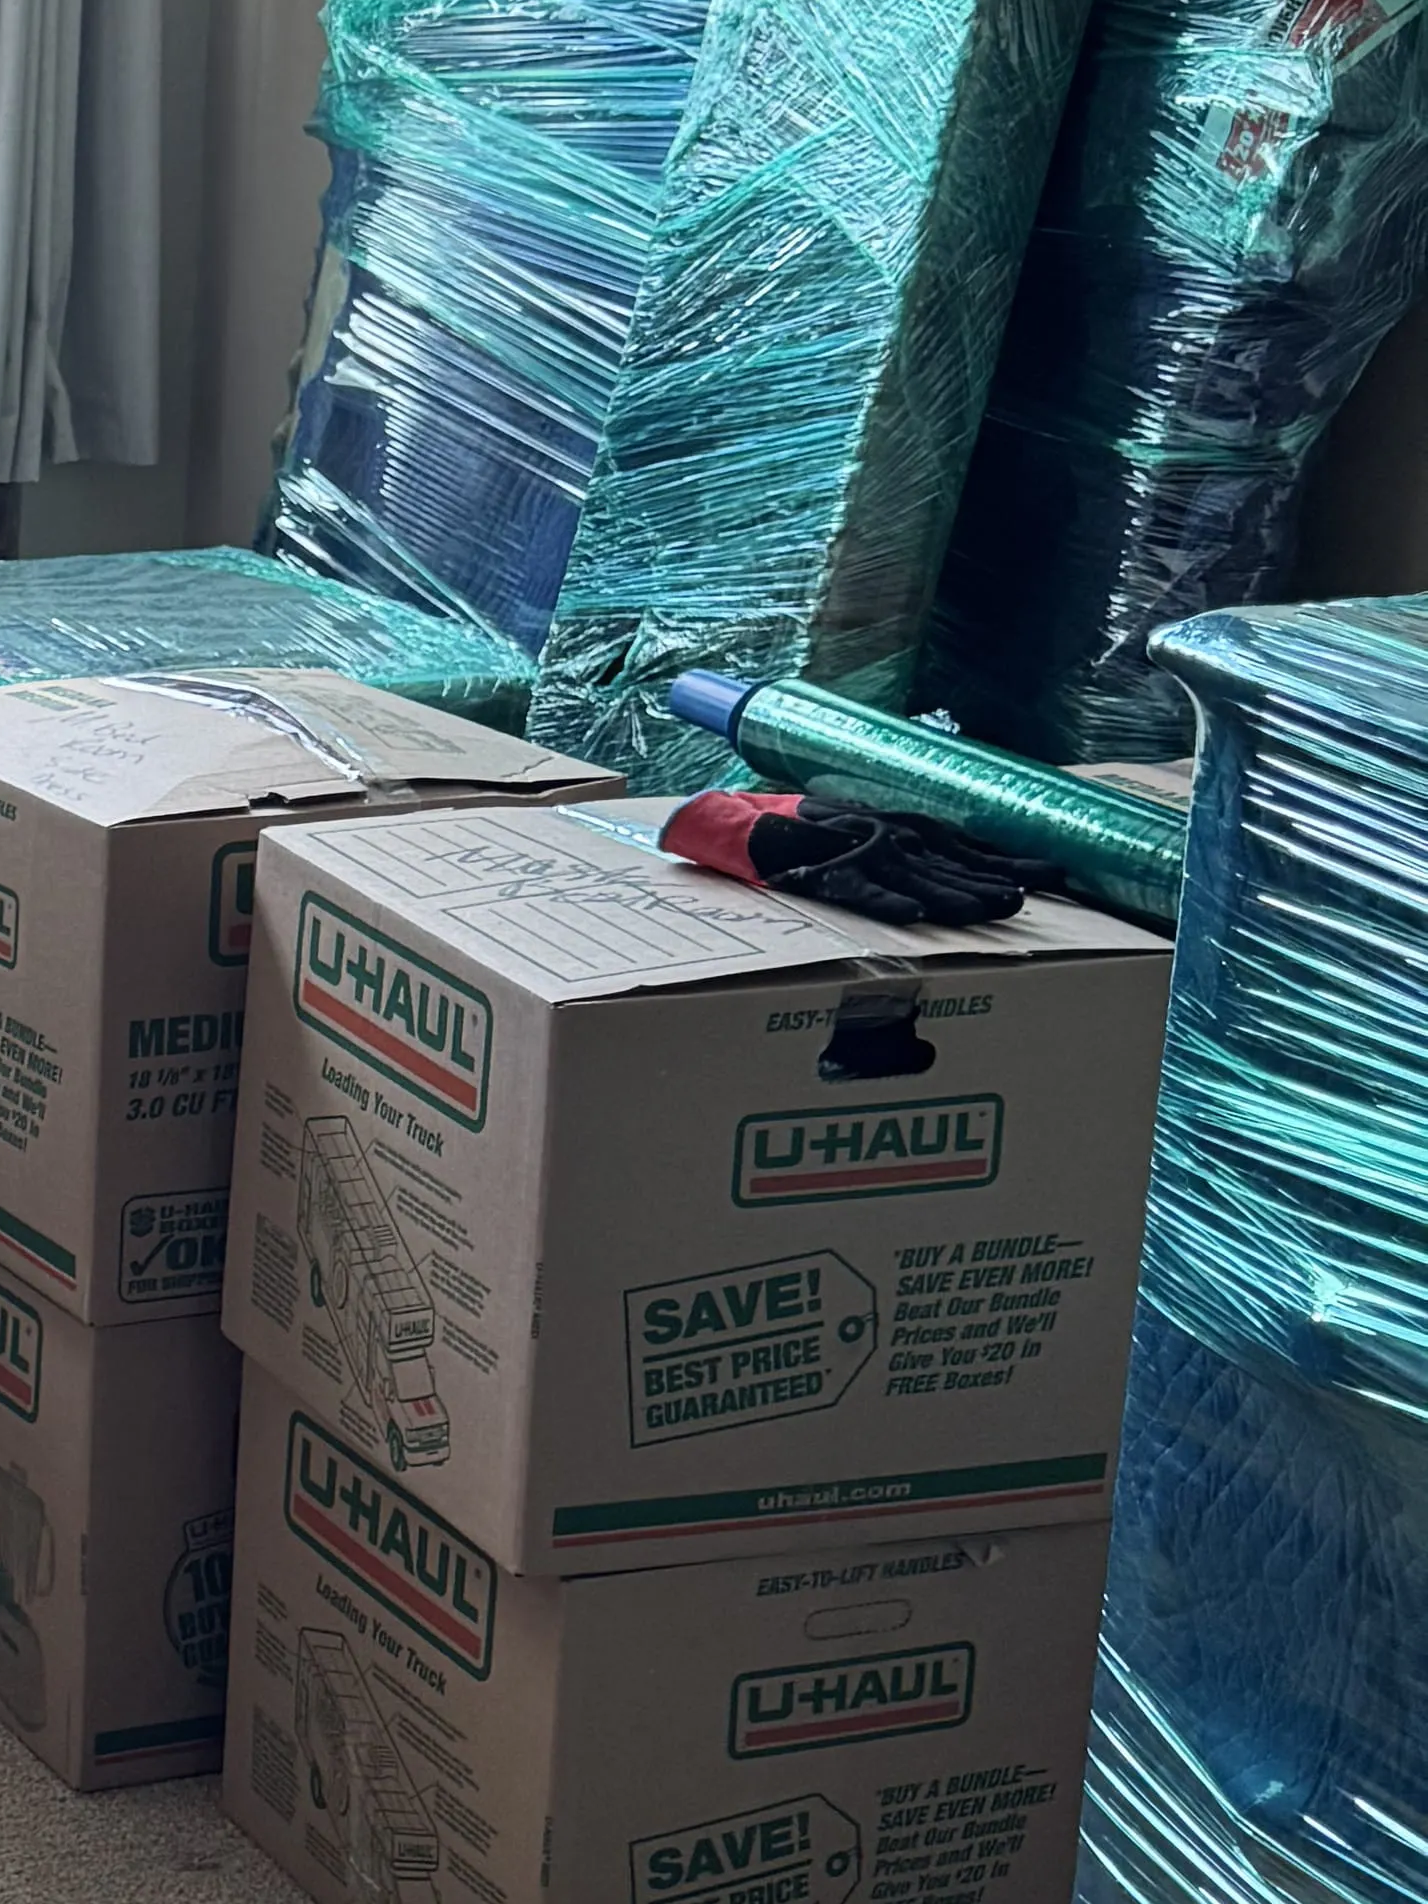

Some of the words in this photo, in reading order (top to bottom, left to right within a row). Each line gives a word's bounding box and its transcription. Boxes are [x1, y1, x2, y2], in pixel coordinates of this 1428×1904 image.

[307, 916, 476, 1073] U-HAUL
[765, 1006, 839, 1033] EASY-T
[918, 995, 993, 1019] ANDLES
[126, 1096, 165, 1121] 3.0
[172, 1091, 206, 1116] CU
[321, 1057, 370, 1111] Loading
[373, 1092, 403, 1129] Your
[405, 1113, 445, 1158] Truck
[754, 1112, 986, 1170] U-HAUL
[896, 1271, 955, 1297] SAVE
[958, 1265, 1016, 1290] EVEN
[1019, 1257, 1095, 1285] MORE!
[948, 1243, 966, 1264] A
[642, 1268, 822, 1344] SAVE!
[891, 1324, 957, 1347] Prices
[960, 1318, 1002, 1340] and
[1007, 1311, 1058, 1336] We'll
[894, 1299, 942, 1322] Beat
[946, 1296, 986, 1317] Our
[989, 1287, 1062, 1313] Bundle
[644, 1357, 722, 1398] BEST
[731, 1335, 821, 1379] PRICE
[885, 1372, 941, 1397] FREE
[943, 1364, 1015, 1390] Boxes!
[888, 1350, 934, 1372] Give
[941, 1346, 978, 1367] You
[980, 1340, 1016, 1363] $20
[646, 1368, 831, 1429] GUARANTEED
[299, 1437, 479, 1625] U-HAUL
[756, 1563, 880, 1597] EASY-TO-LIFT
[880, 1552, 966, 1579] HANDLES
[316, 1573, 368, 1634] Loading
[372, 1617, 403, 1658] Your
[406, 1647, 447, 1695] Truck
[747, 1660, 958, 1724] U-HAUL
[877, 1805, 930, 1831] SAVE
[934, 1797, 987, 1823] EVEN
[990, 1782, 1058, 1813] MORE!
[924, 1779, 940, 1799] A
[647, 1811, 811, 1890] SAVE!
